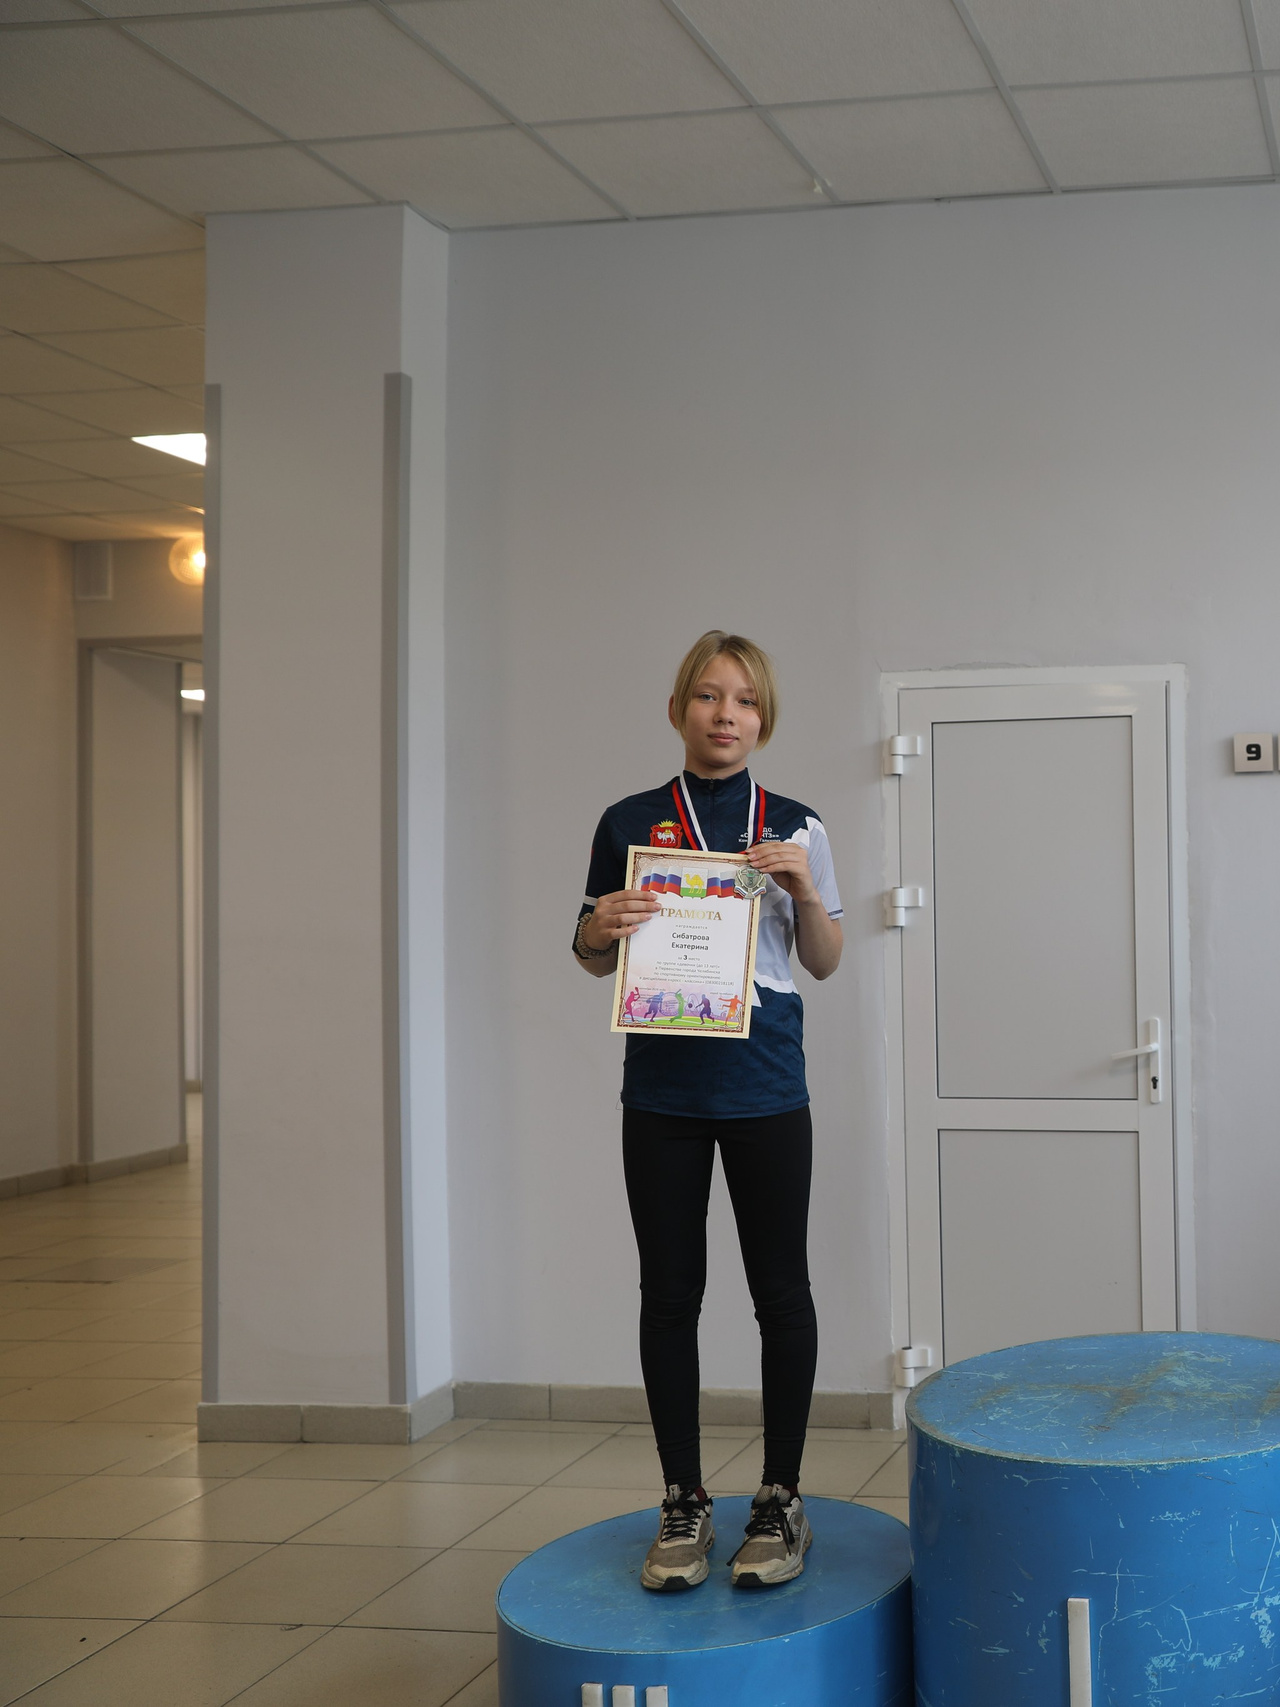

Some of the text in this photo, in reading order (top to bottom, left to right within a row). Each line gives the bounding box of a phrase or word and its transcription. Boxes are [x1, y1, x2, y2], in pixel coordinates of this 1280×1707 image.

[1246, 744, 1261, 761] 9
[660, 908, 722, 920] ГРАМОТА
[672, 932, 710, 941] Сибатрова
[671, 942, 709, 951] Екатерина
